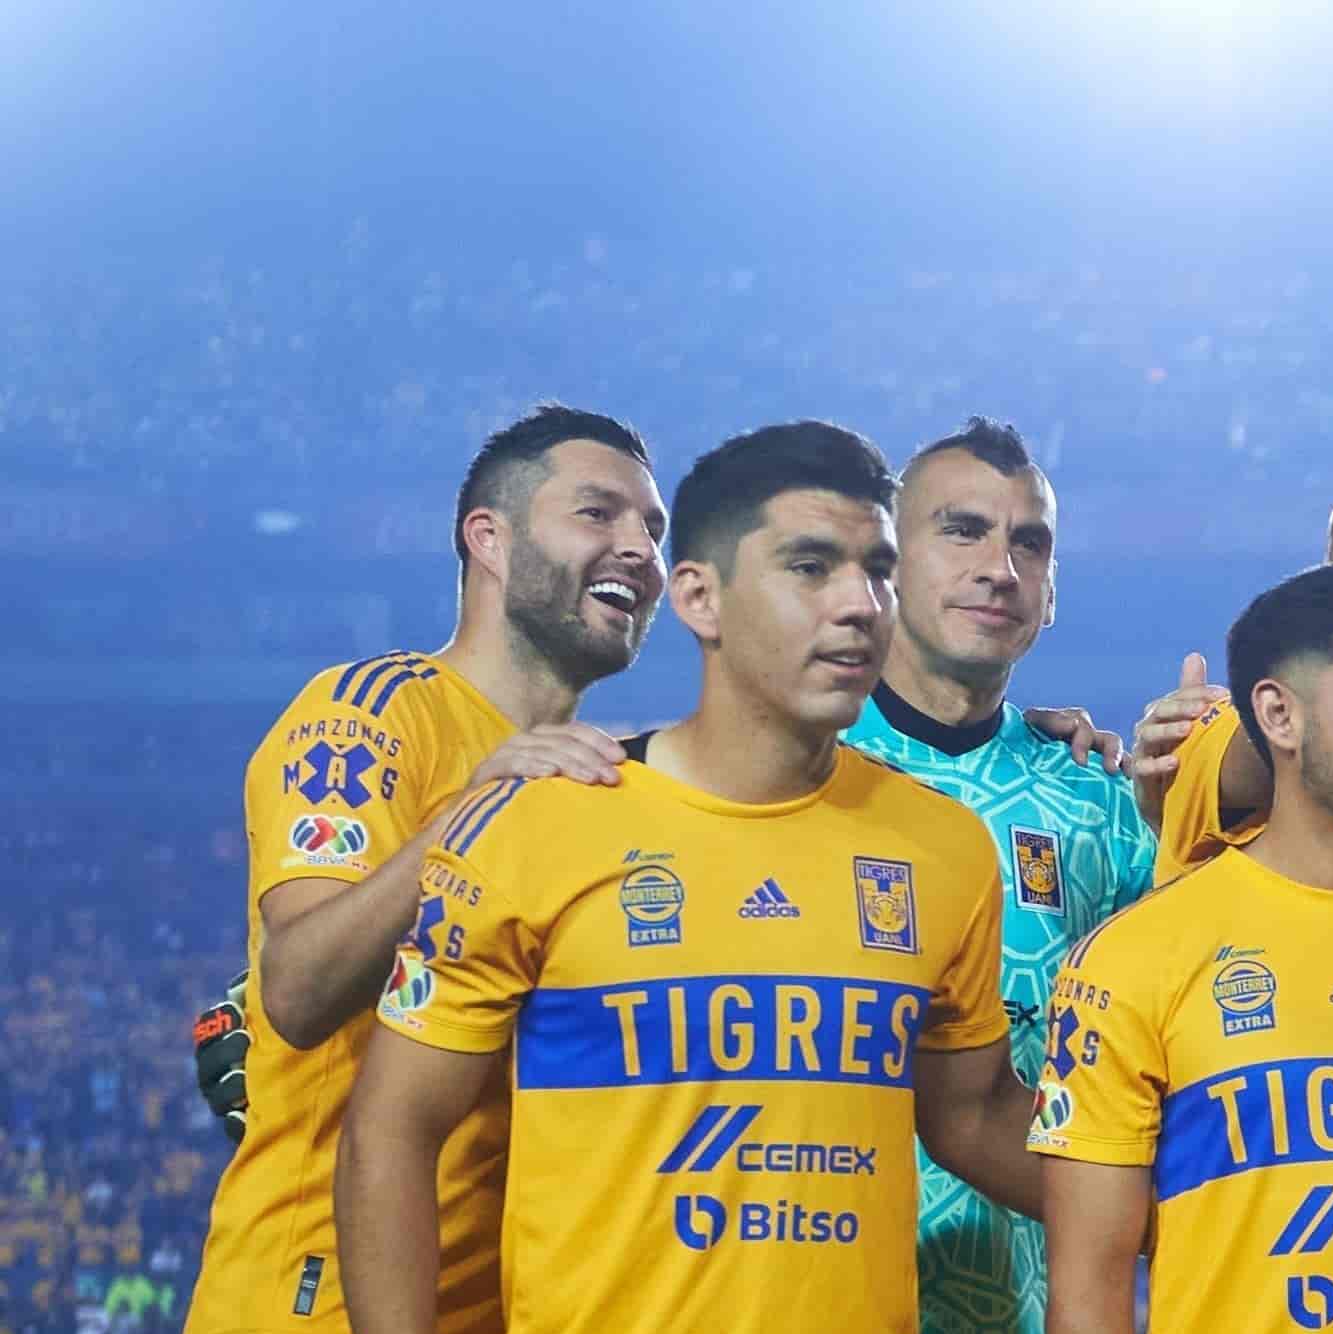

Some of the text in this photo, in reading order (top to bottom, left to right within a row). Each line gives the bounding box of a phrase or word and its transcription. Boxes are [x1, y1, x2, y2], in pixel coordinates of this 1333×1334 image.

[738, 902, 801, 919] adidas
[602, 983, 920, 1079] TIGRES
[1226, 1013, 1272, 1034] EXTRA
[737, 1142, 877, 1176] CEMEX
[739, 1198, 860, 1243] Bitso
